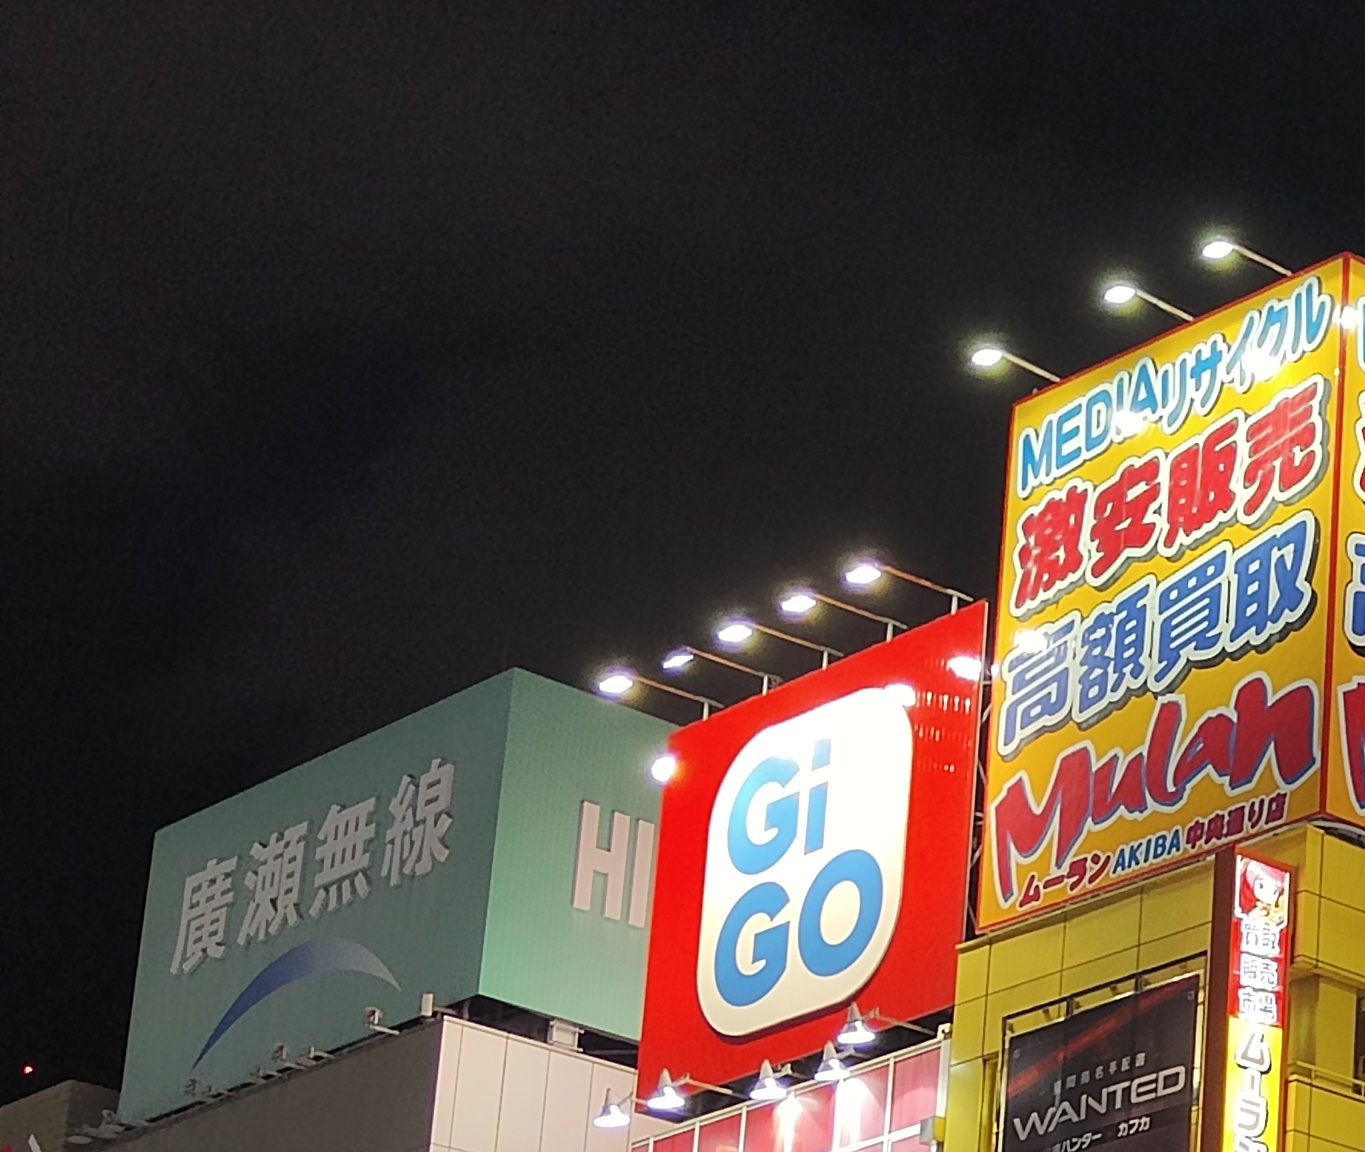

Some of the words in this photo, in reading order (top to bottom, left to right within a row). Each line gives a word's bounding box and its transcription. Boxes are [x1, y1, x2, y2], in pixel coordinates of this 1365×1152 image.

[1013, 390, 1323, 602] 激安販売
[1002, 518, 1314, 750] 高額買取
[170, 757, 455, 976] 廣瀬無線
[572, 800, 656, 929] HI
[996, 678, 1318, 902] Mulan
[1019, 850, 1111, 908] ムーラン
[1112, 833, 1182, 875] AKIBA
[1185, 793, 1287, 848] 中央通り店
[1013, 1065, 1186, 1141] WANTED
[1117, 1116, 1151, 1138] カフカ
